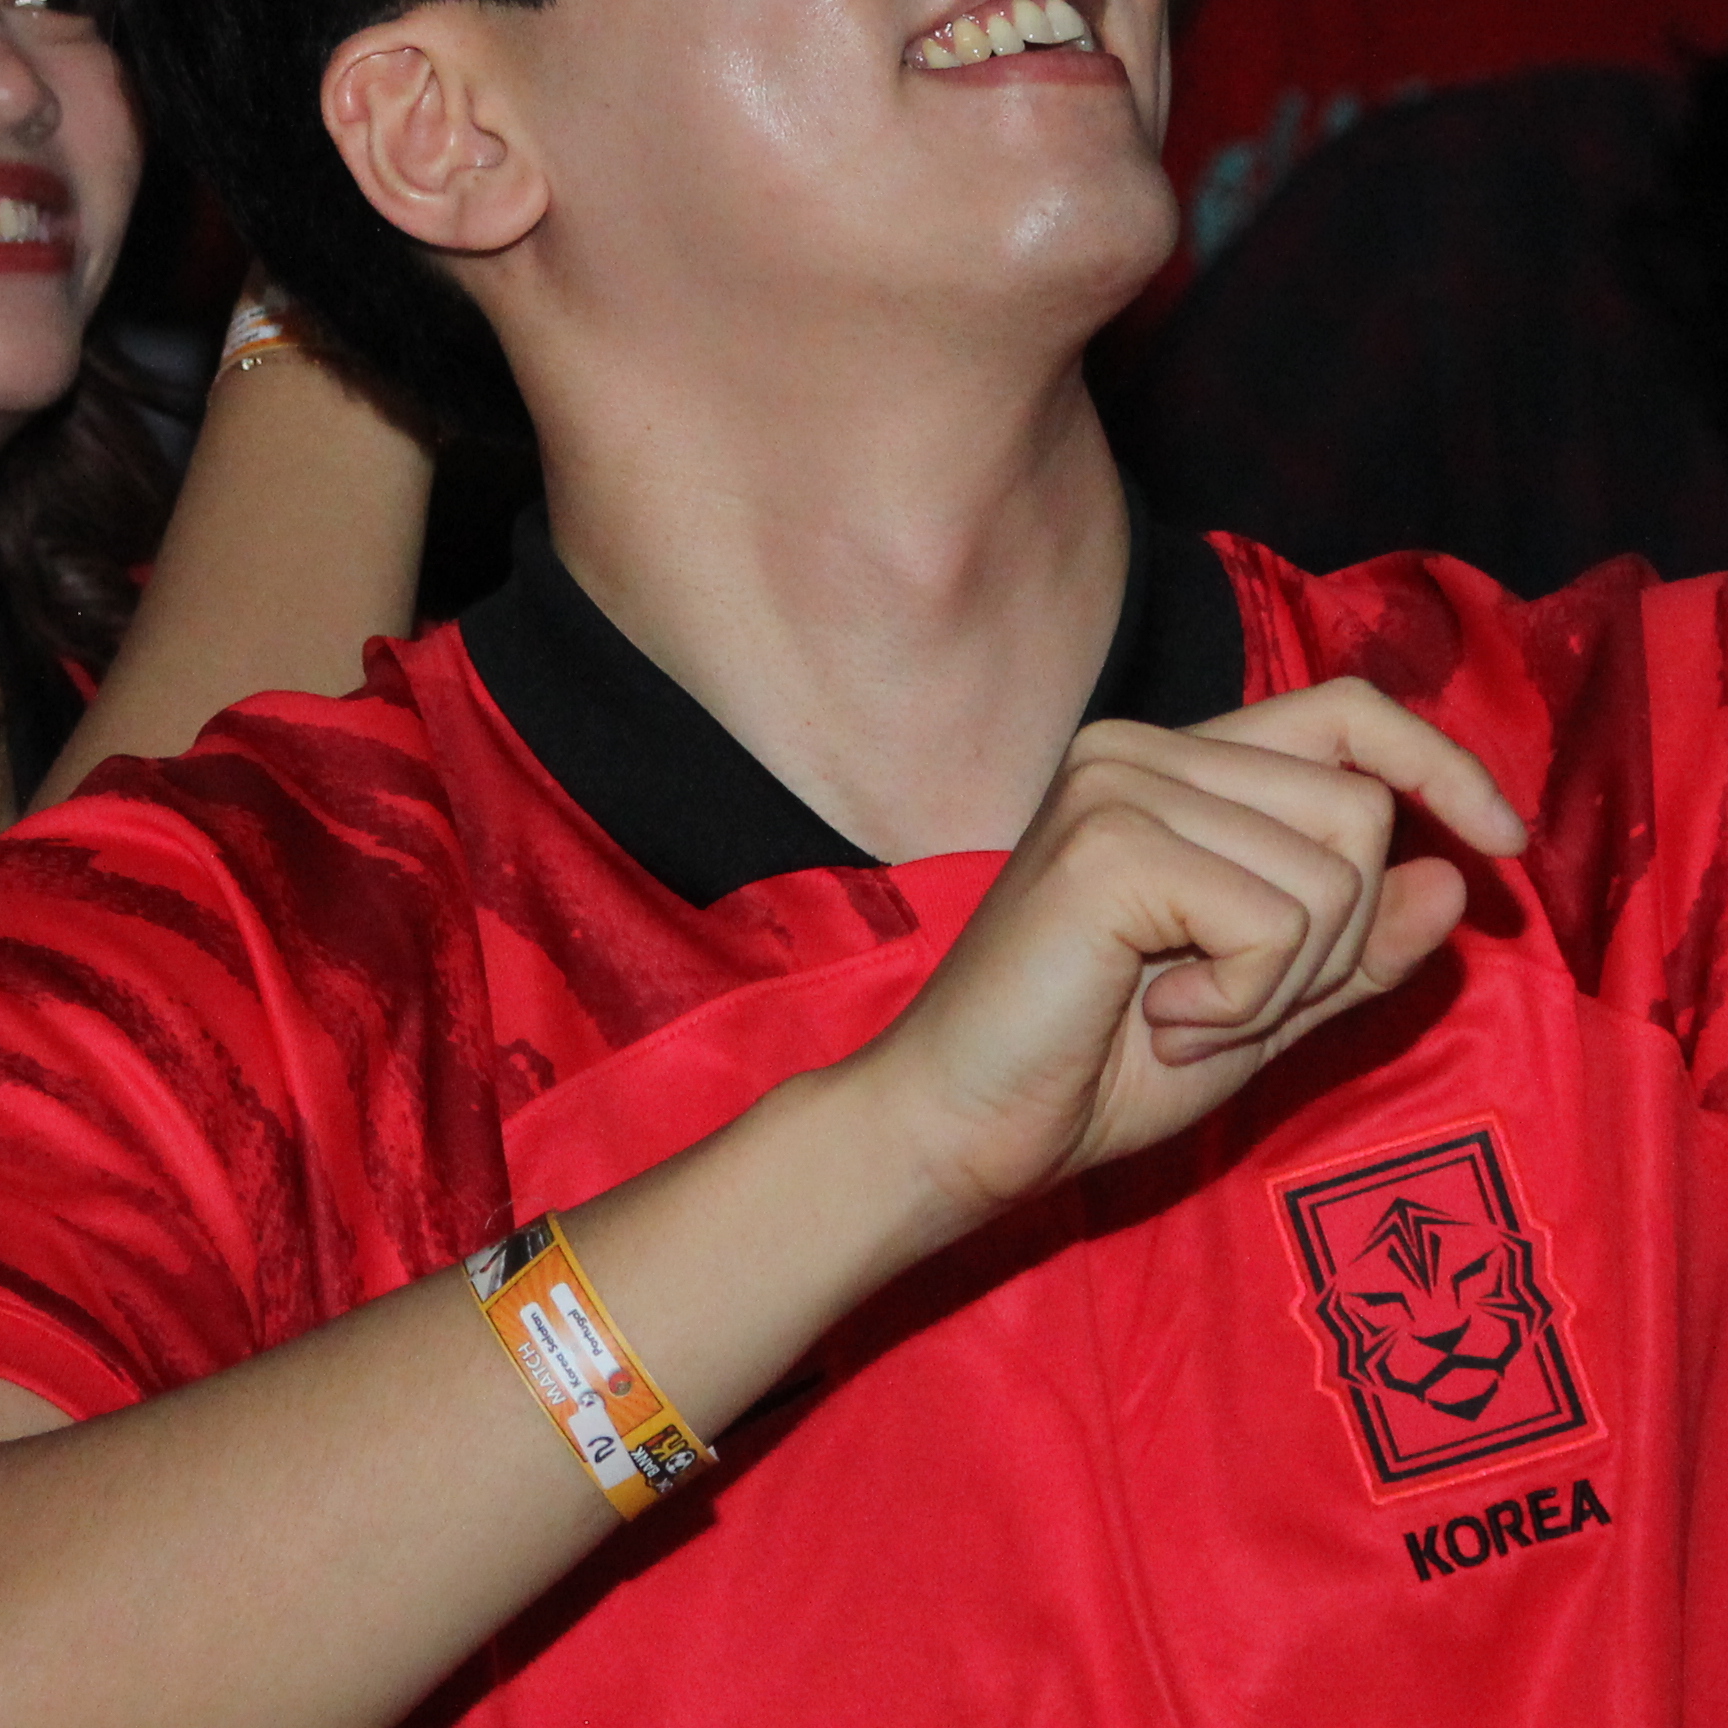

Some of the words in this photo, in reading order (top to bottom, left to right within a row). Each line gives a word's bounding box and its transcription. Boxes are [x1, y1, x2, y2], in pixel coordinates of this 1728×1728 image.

[530, 1311, 559, 1354] Selatan
[567, 1308, 604, 1357] Portugal
[517, 1341, 568, 1406] MATCH
[555, 1352, 582, 1389] Korea
[630, 1445, 661, 1478] BANK
[1403, 1478, 1612, 1583] KOREA
